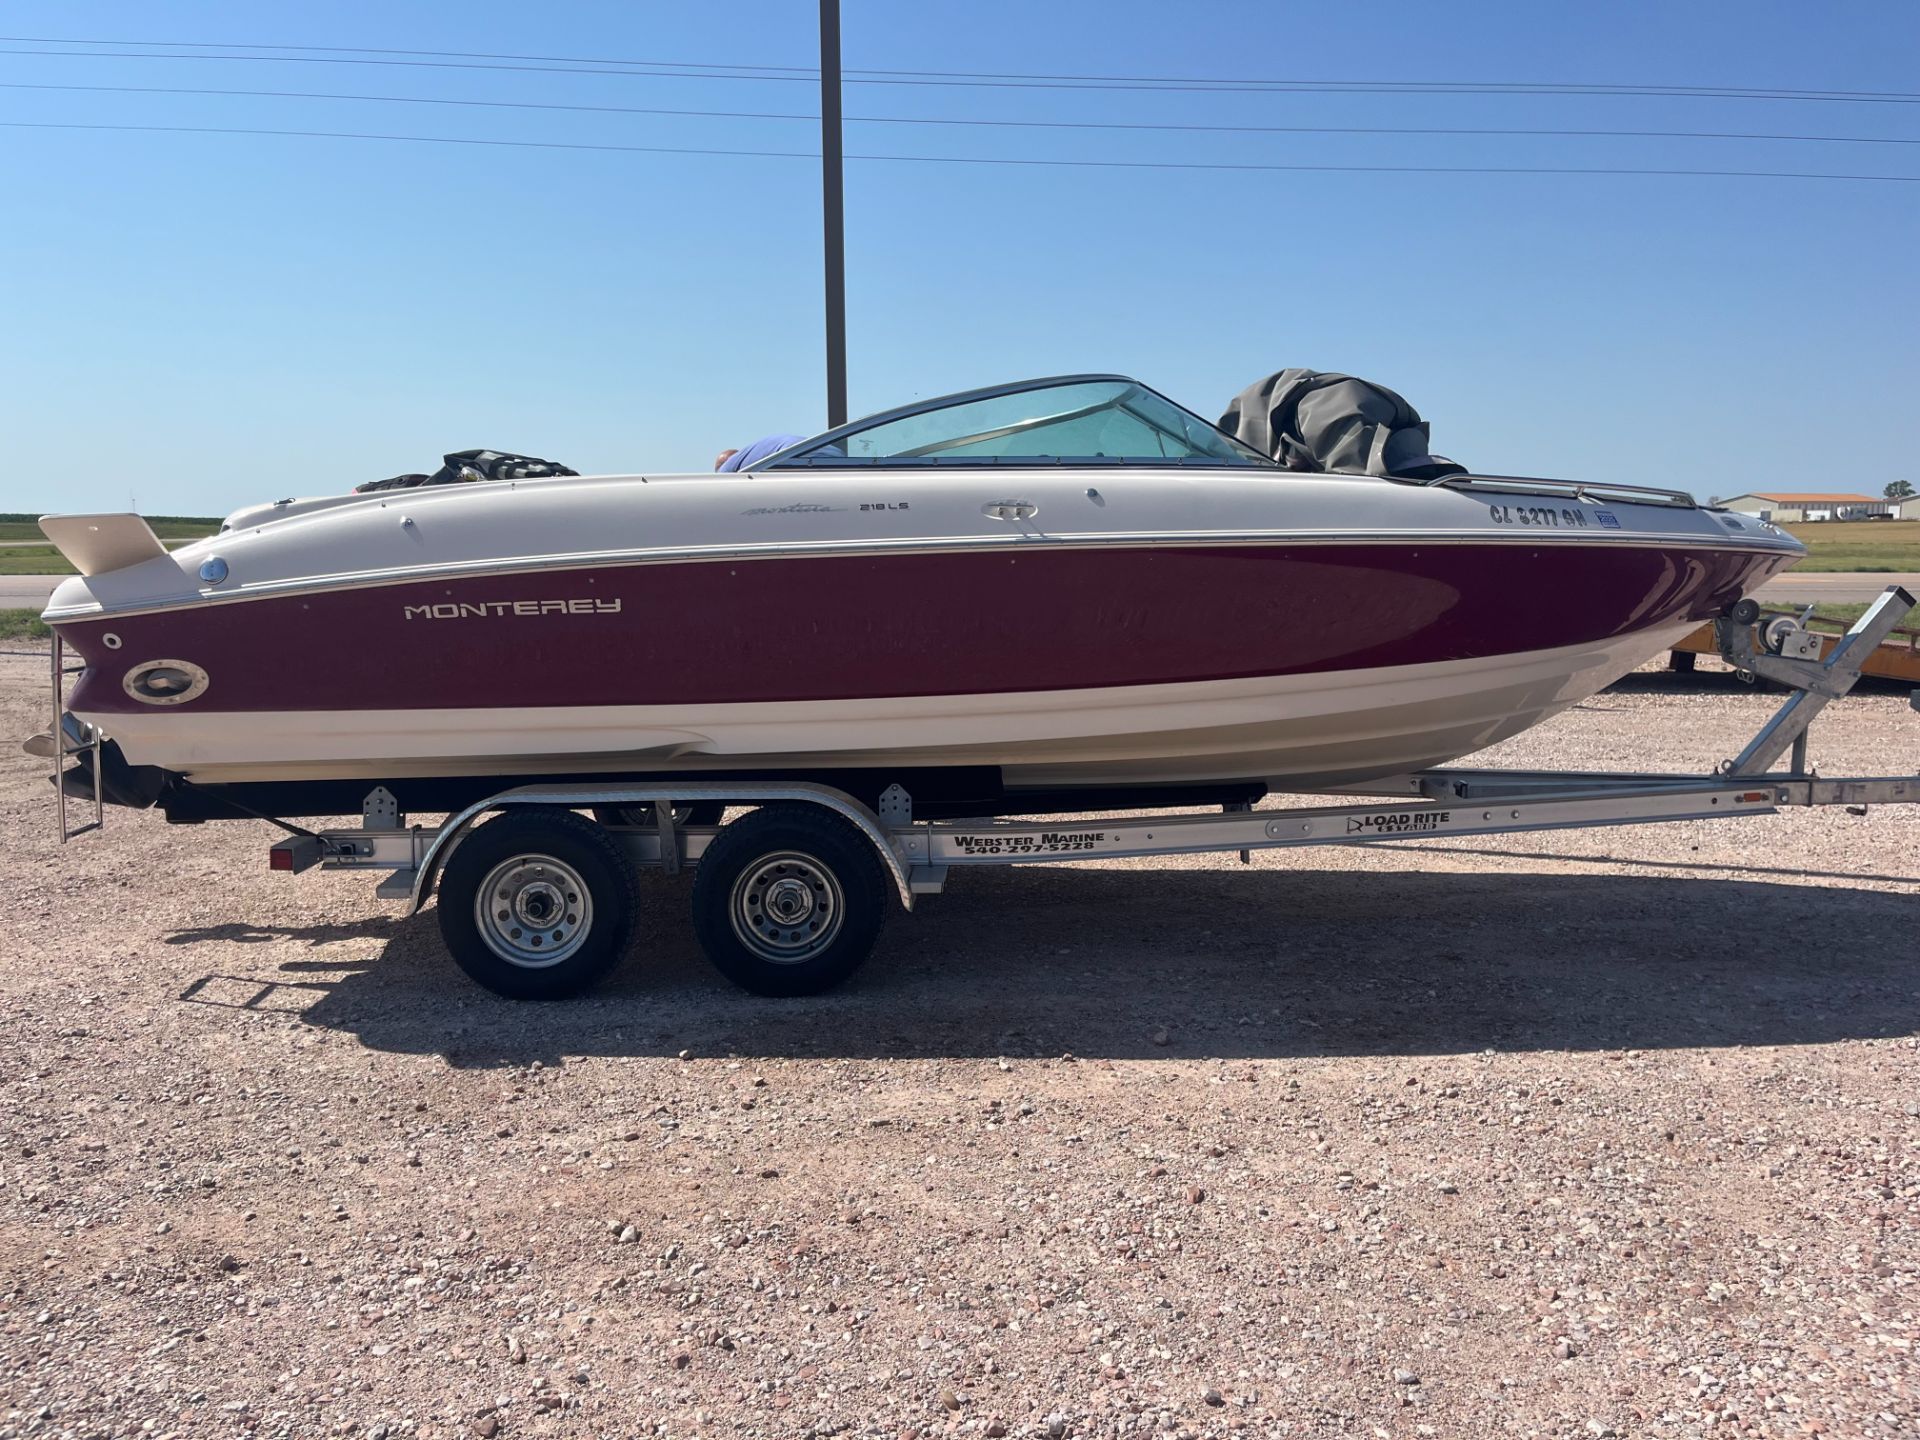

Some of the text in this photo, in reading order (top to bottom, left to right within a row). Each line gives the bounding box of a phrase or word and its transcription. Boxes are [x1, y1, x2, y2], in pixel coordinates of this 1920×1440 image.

[888, 502, 909, 510] LS
[1490, 505, 1513, 523] CL
[404, 598, 622, 620] MONTEREY
[1364, 812, 1450, 827] LOAD RITE
[954, 833, 1105, 847] WEBSTER MARINE
[964, 842, 1095, 855] 540-297-5228
